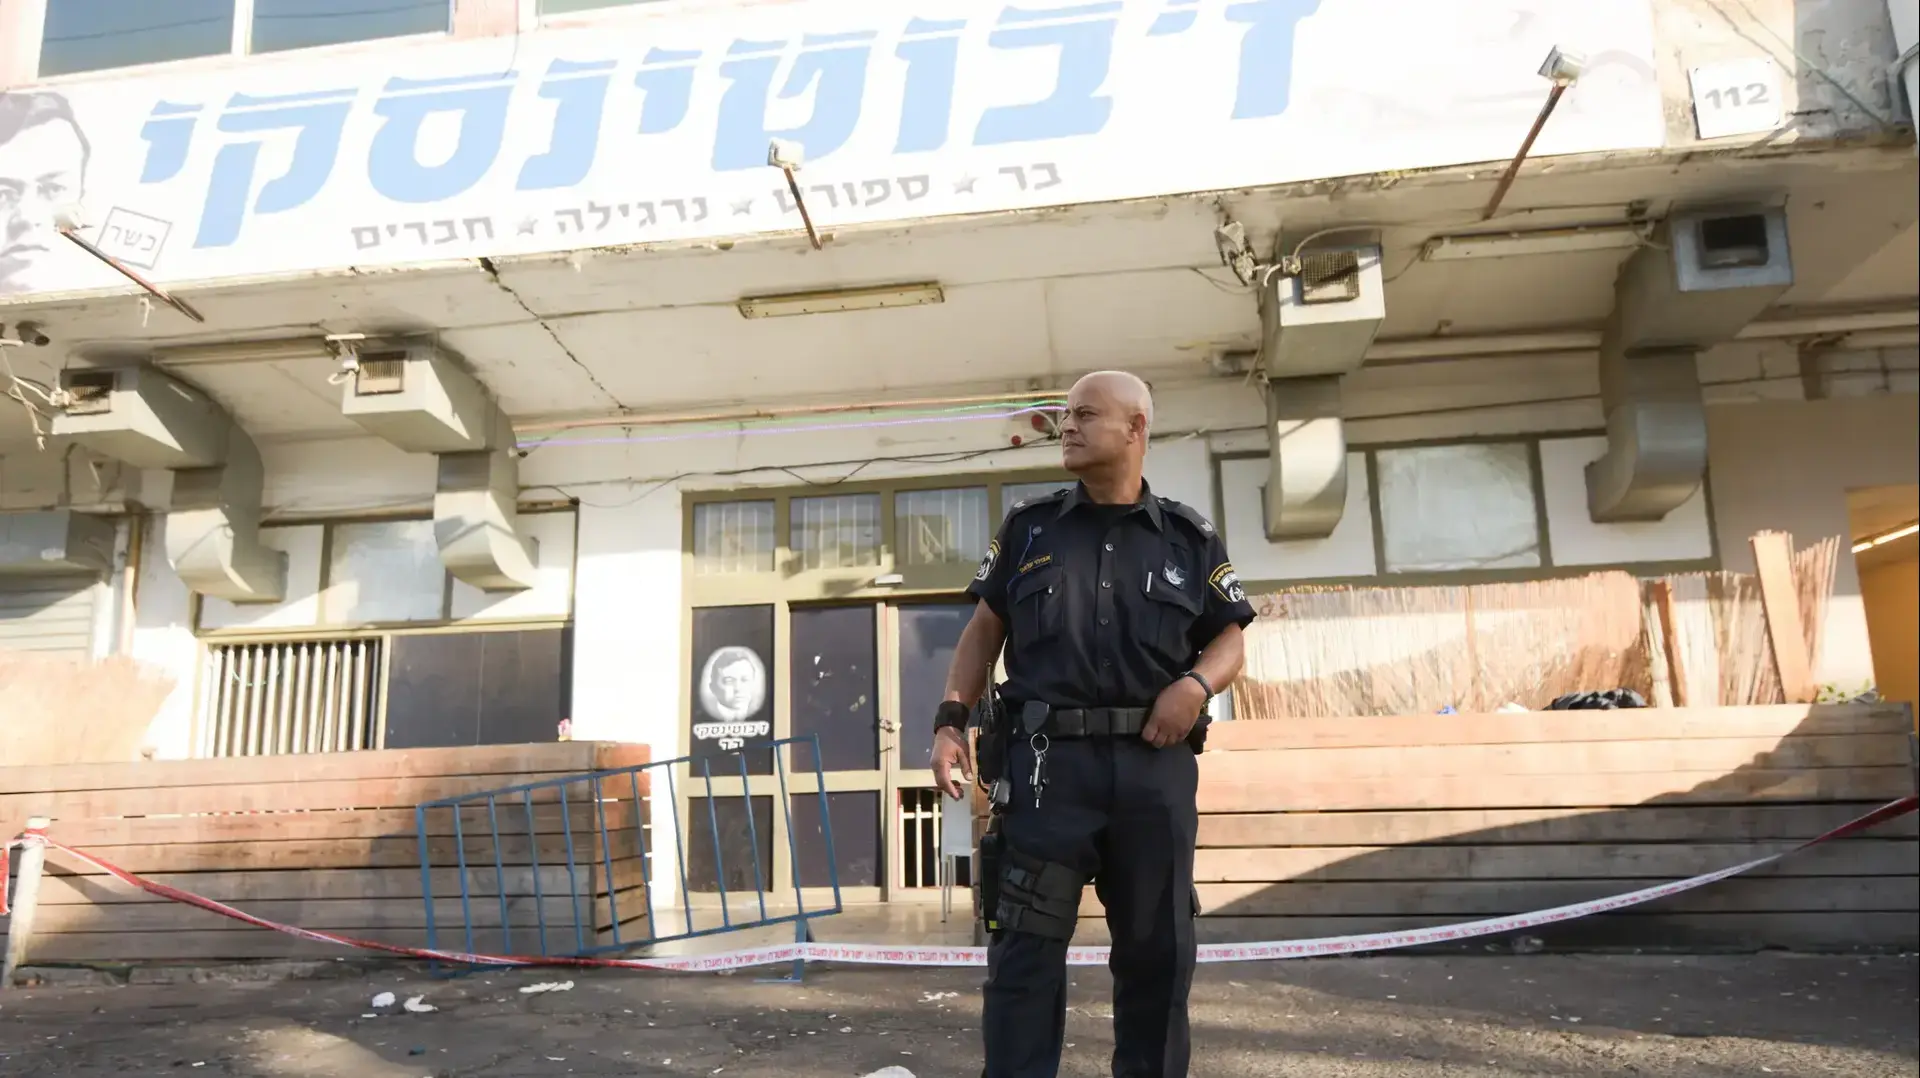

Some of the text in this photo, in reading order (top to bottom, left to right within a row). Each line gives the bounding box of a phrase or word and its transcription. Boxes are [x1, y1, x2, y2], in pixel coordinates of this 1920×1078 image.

[1704, 82, 1770, 109] 112
[350, 162, 1063, 250] בר ספורט נרגילה חברים
[109, 223, 157, 253] כשר
